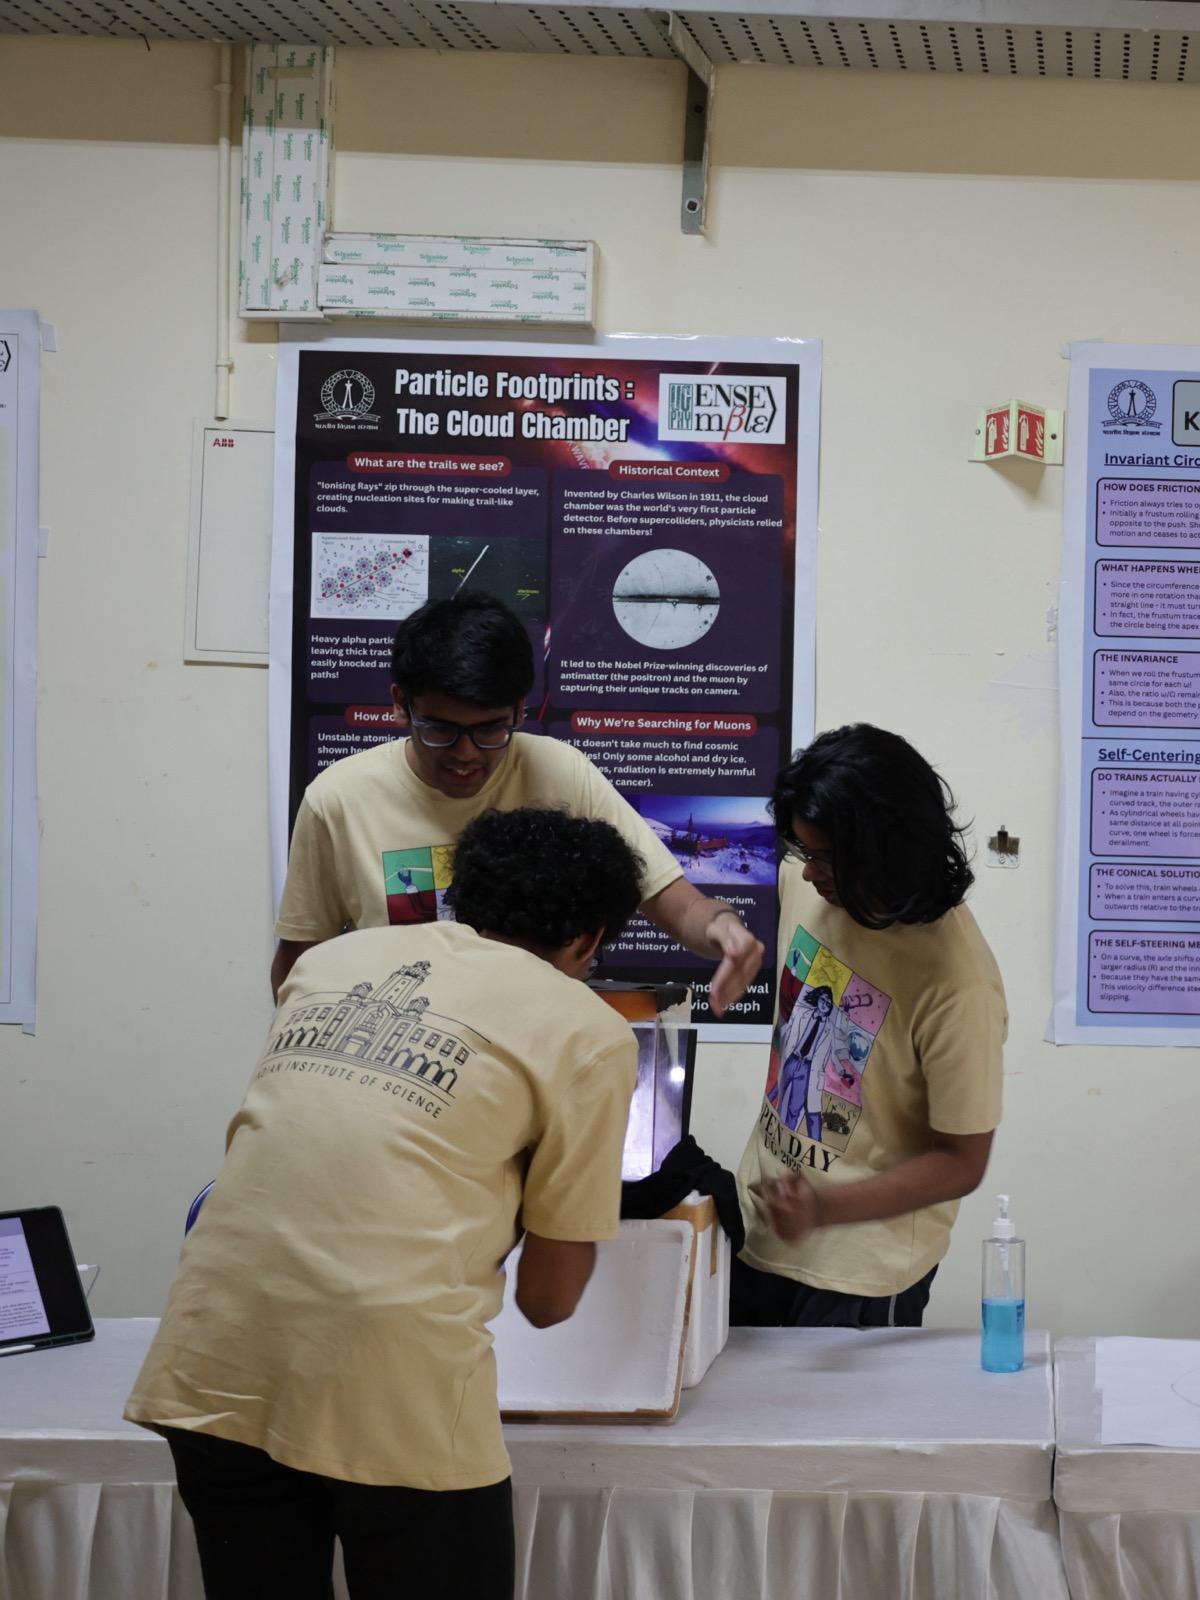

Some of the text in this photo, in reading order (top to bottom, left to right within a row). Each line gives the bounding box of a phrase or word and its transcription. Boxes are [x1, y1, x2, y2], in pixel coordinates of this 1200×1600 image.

[395, 369, 489, 396] Particle
[496, 373, 619, 403] Footprints
[397, 408, 630, 442] The Cloud Chamber
[212, 438, 234, 448] ABB
[1104, 453, 1170, 465] Invariant
[354, 458, 384, 467] What
[407, 459, 426, 468] the
[428, 460, 458, 470] trails
[479, 462, 504, 471] see?
[619, 465, 719, 477] Historical Context
[317, 482, 356, 491] "Ionising
[358, 482, 383, 492] Rays"
[384, 483, 398, 492] zip
[399, 484, 435, 494] through
[515, 487, 539, 497] layer,
[1104, 483, 1127, 491] HOW
[1129, 484, 1155, 492] DOES
[1157, 484, 1200, 493] FRICTION
[564, 490, 605, 498] Invented
[607, 490, 619, 500] by
[620, 491, 655, 499] Charles
[656, 492, 688, 500] Wilson
[700, 493, 724, 502] 1911,
[725, 494, 741, 502] the
[742, 494, 768, 502] cloud
[577, 526, 603, 534] these
[604, 527, 652, 536] chambers!
[1131, 565, 1175, 573] HAPPENS
[311, 635, 394, 645] Heavy alpha partic
[311, 647, 344, 657] leaving
[311, 659, 377, 668] easily knocked
[1100, 654, 1178, 664] THE INVARIANCE
[643, 662, 704, 672] Prize-winning
[705, 664, 757, 672] discoveries
[311, 671, 339, 680] paths!
[354, 712, 379, 721] How
[577, 717, 751, 731] Why We're Searching for Muons
[318, 733, 396, 742] Unstable atomic
[318, 746, 348, 754] shown
[616, 779, 654, 787] cancer).
[1098, 773, 1112, 781] DO
[1114, 773, 1148, 782] TRAINS
[1150, 774, 1197, 783] ACTUALLY
[1096, 868, 1114, 876] THE
[1116, 869, 1158, 877] CONICAL
[636, 931, 656, 939] with
[618, 942, 681, 952] the history of
[1094, 939, 1113, 947] THE
[1115, 939, 1186, 948] SELF-STEERING
[286, 1060, 354, 1080] INSTITUTE
[360, 1074, 378, 1086] OF
[382, 1082, 442, 1118] SCIENCE
[788, 1135, 840, 1172] DAY
